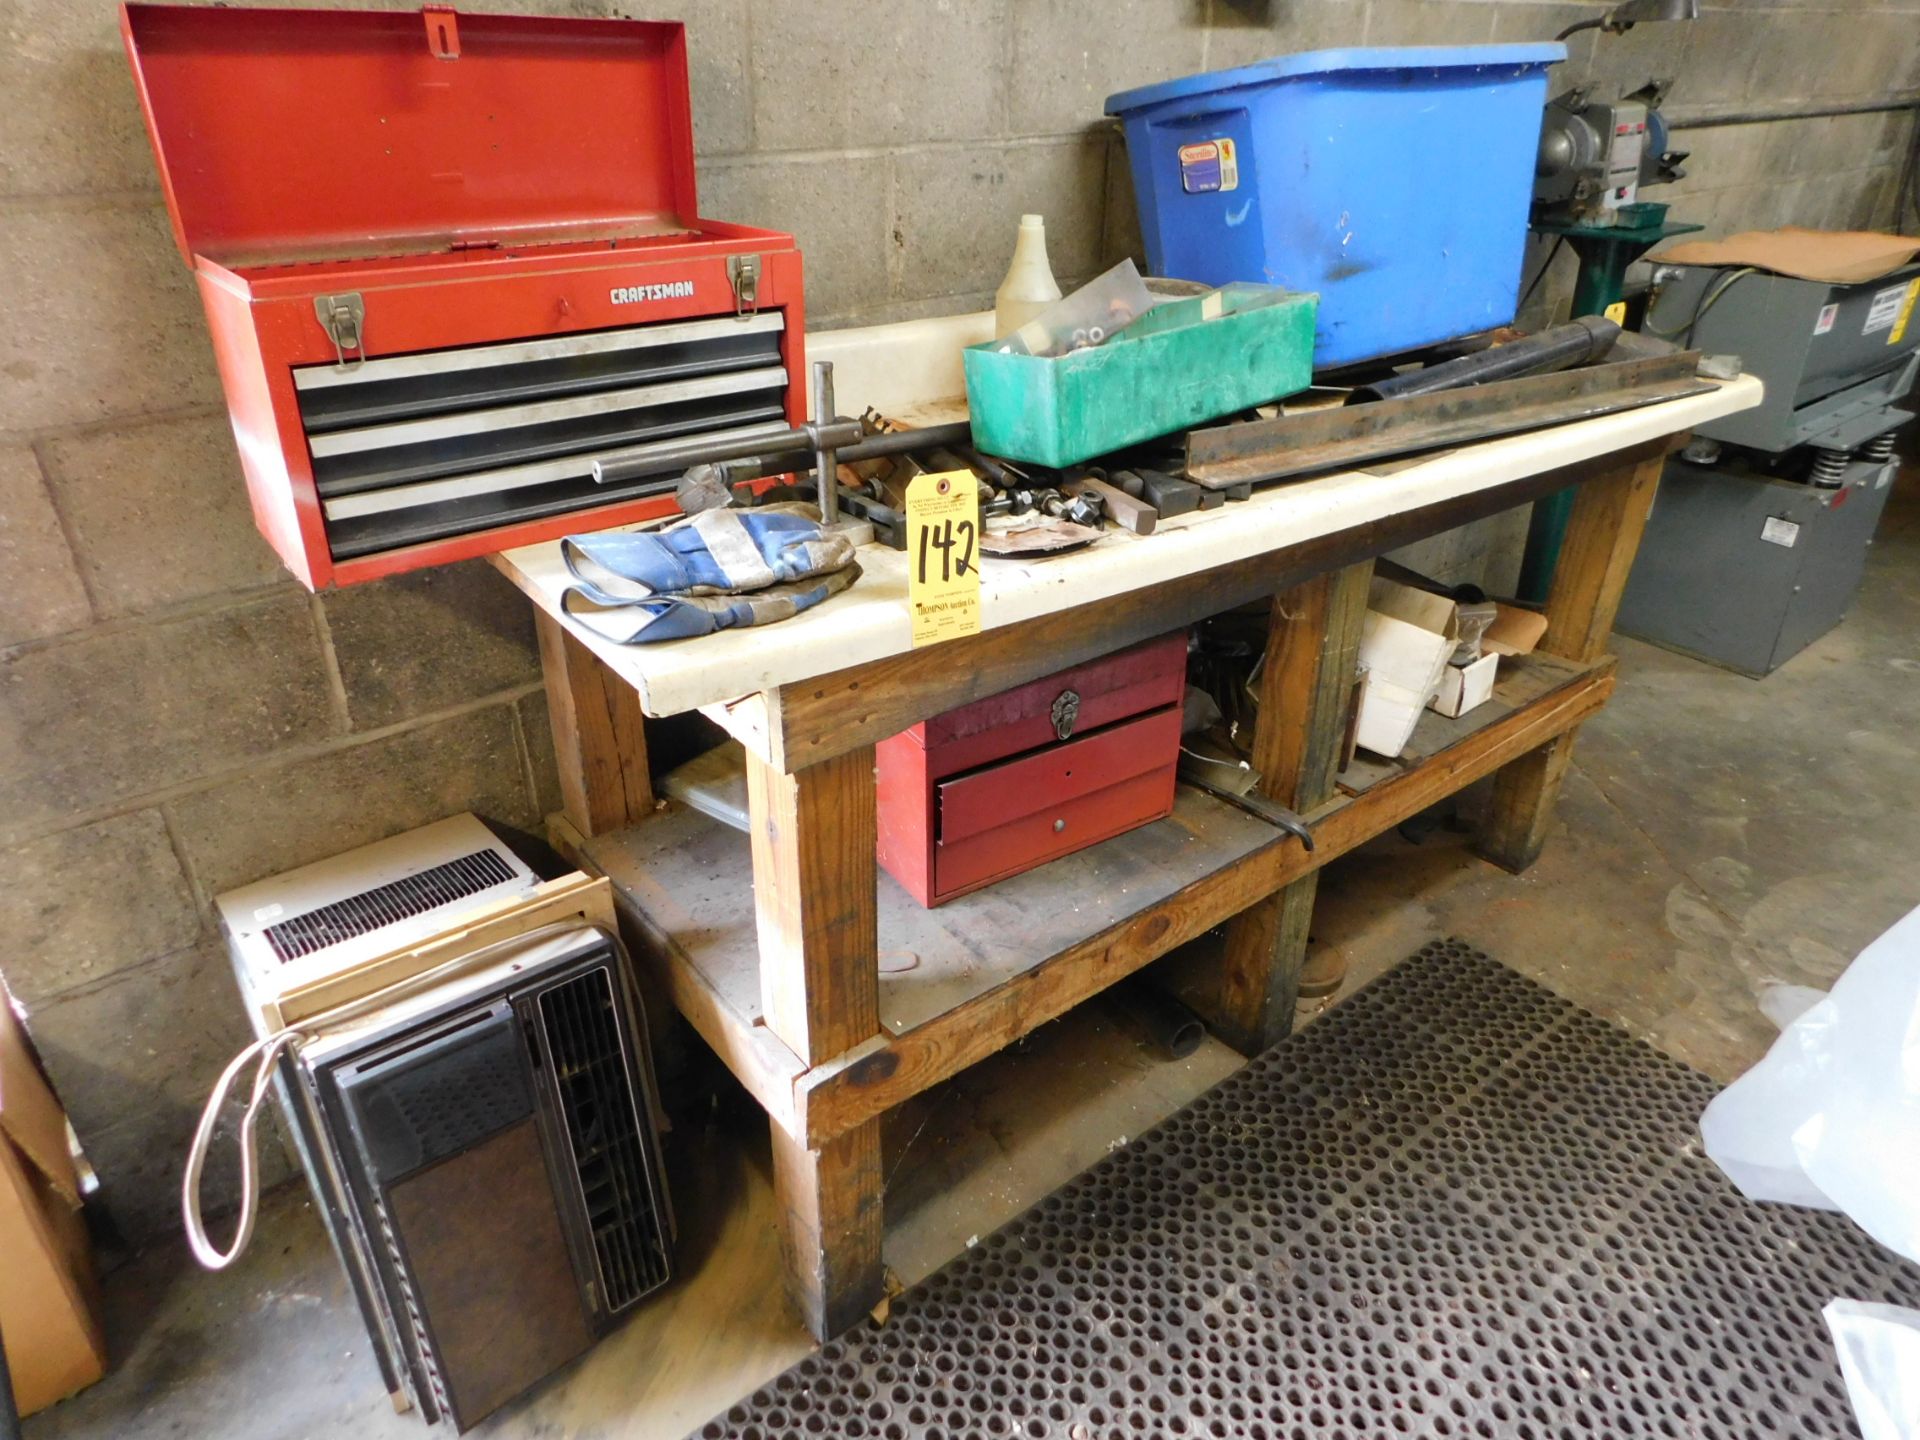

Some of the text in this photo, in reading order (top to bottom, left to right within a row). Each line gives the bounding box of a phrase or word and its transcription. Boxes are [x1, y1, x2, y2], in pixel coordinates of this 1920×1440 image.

[610, 281, 694, 304] CRAFTSMAN
[919, 519, 978, 585] 142
[916, 602, 949, 616] THOMPSON
